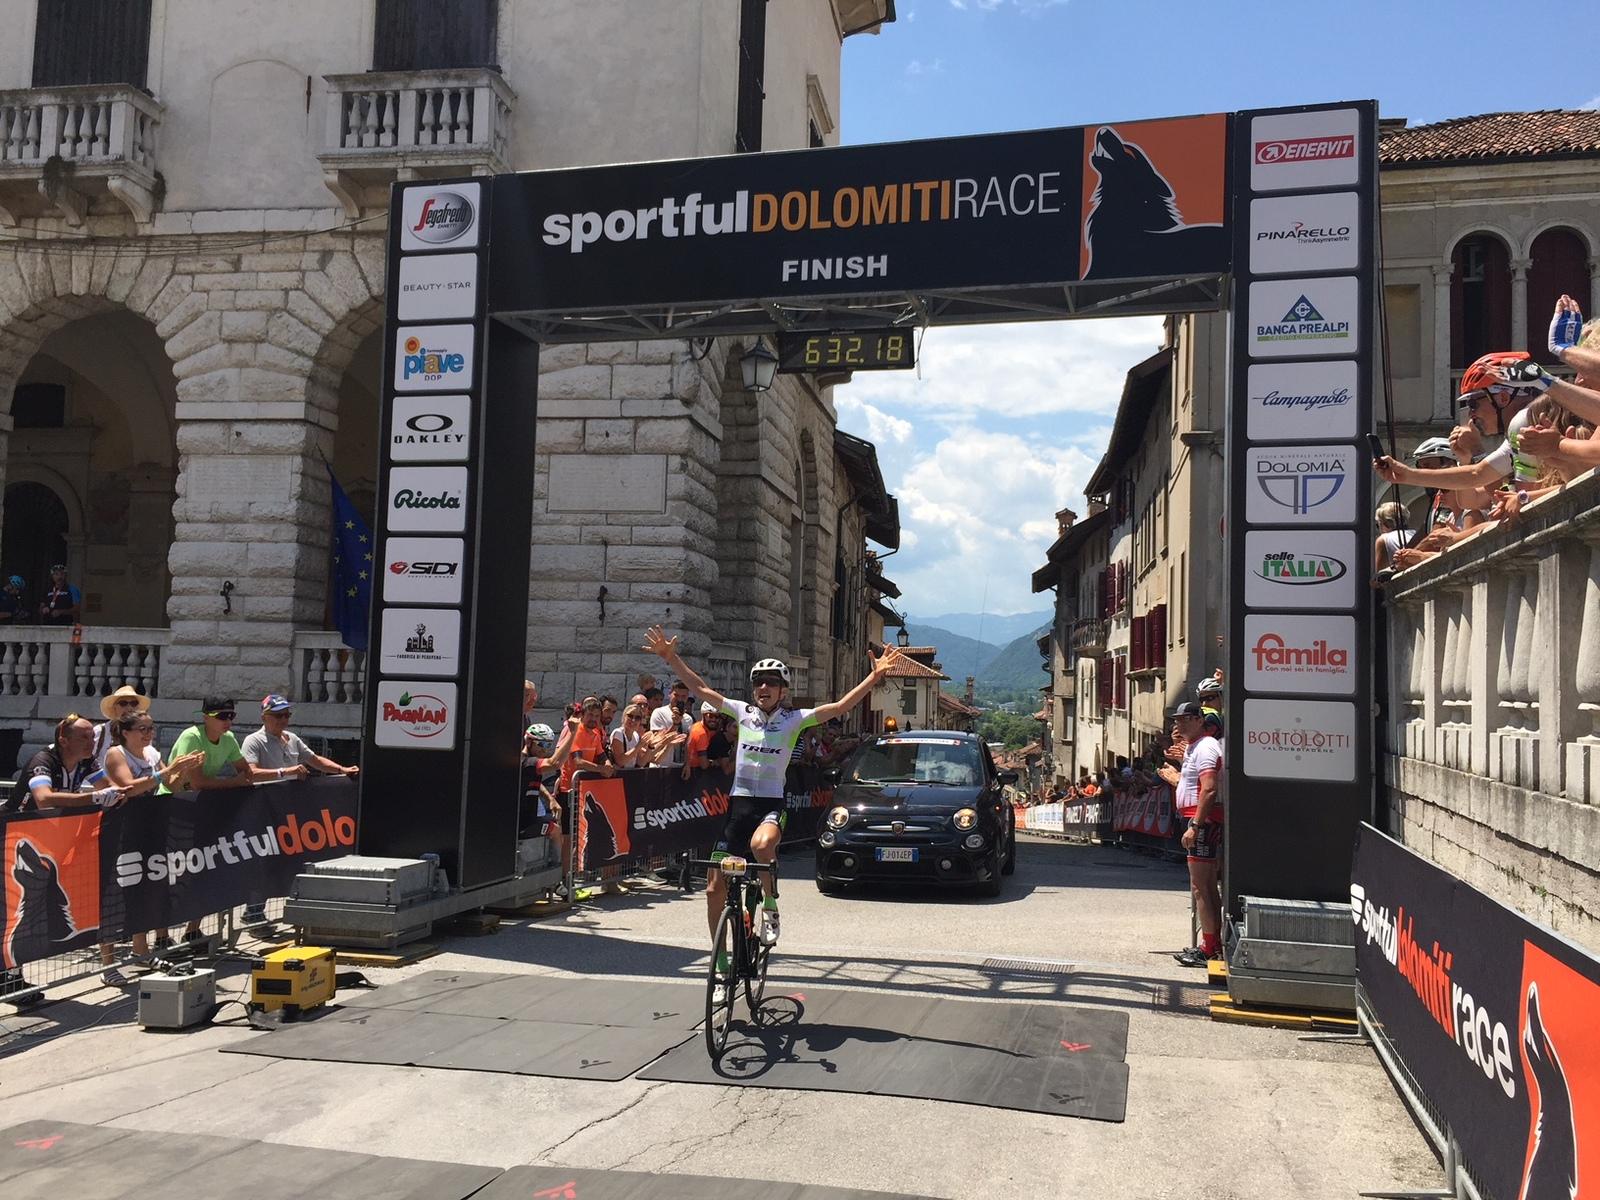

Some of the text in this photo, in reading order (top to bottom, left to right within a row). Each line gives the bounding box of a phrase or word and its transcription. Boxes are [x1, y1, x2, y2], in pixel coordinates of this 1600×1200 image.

[1284, 139, 1353, 159] ENERVIT
[413, 198, 467, 231] Segafredo
[1256, 226, 1350, 241] PINARELLO
[781, 254, 888, 282] FINISH
[403, 281, 471, 292] BEAUTY STAR
[1257, 321, 1349, 336] BANCA PREALPI
[403, 347, 465, 380] piave
[1261, 388, 1352, 411] Campagnolo
[394, 434, 464, 444] OAKLEY
[1257, 459, 1344, 473] DOLOMIA
[393, 489, 461, 509] Ricola
[1264, 552, 1295, 560] selle
[1263, 560, 1333, 577] ITALIA
[1251, 633, 1347, 671] famila
[383, 702, 447, 726] PAGNAN
[1248, 731, 1349, 748] BORTOLOTTI
[741, 743, 782, 755] TREK
